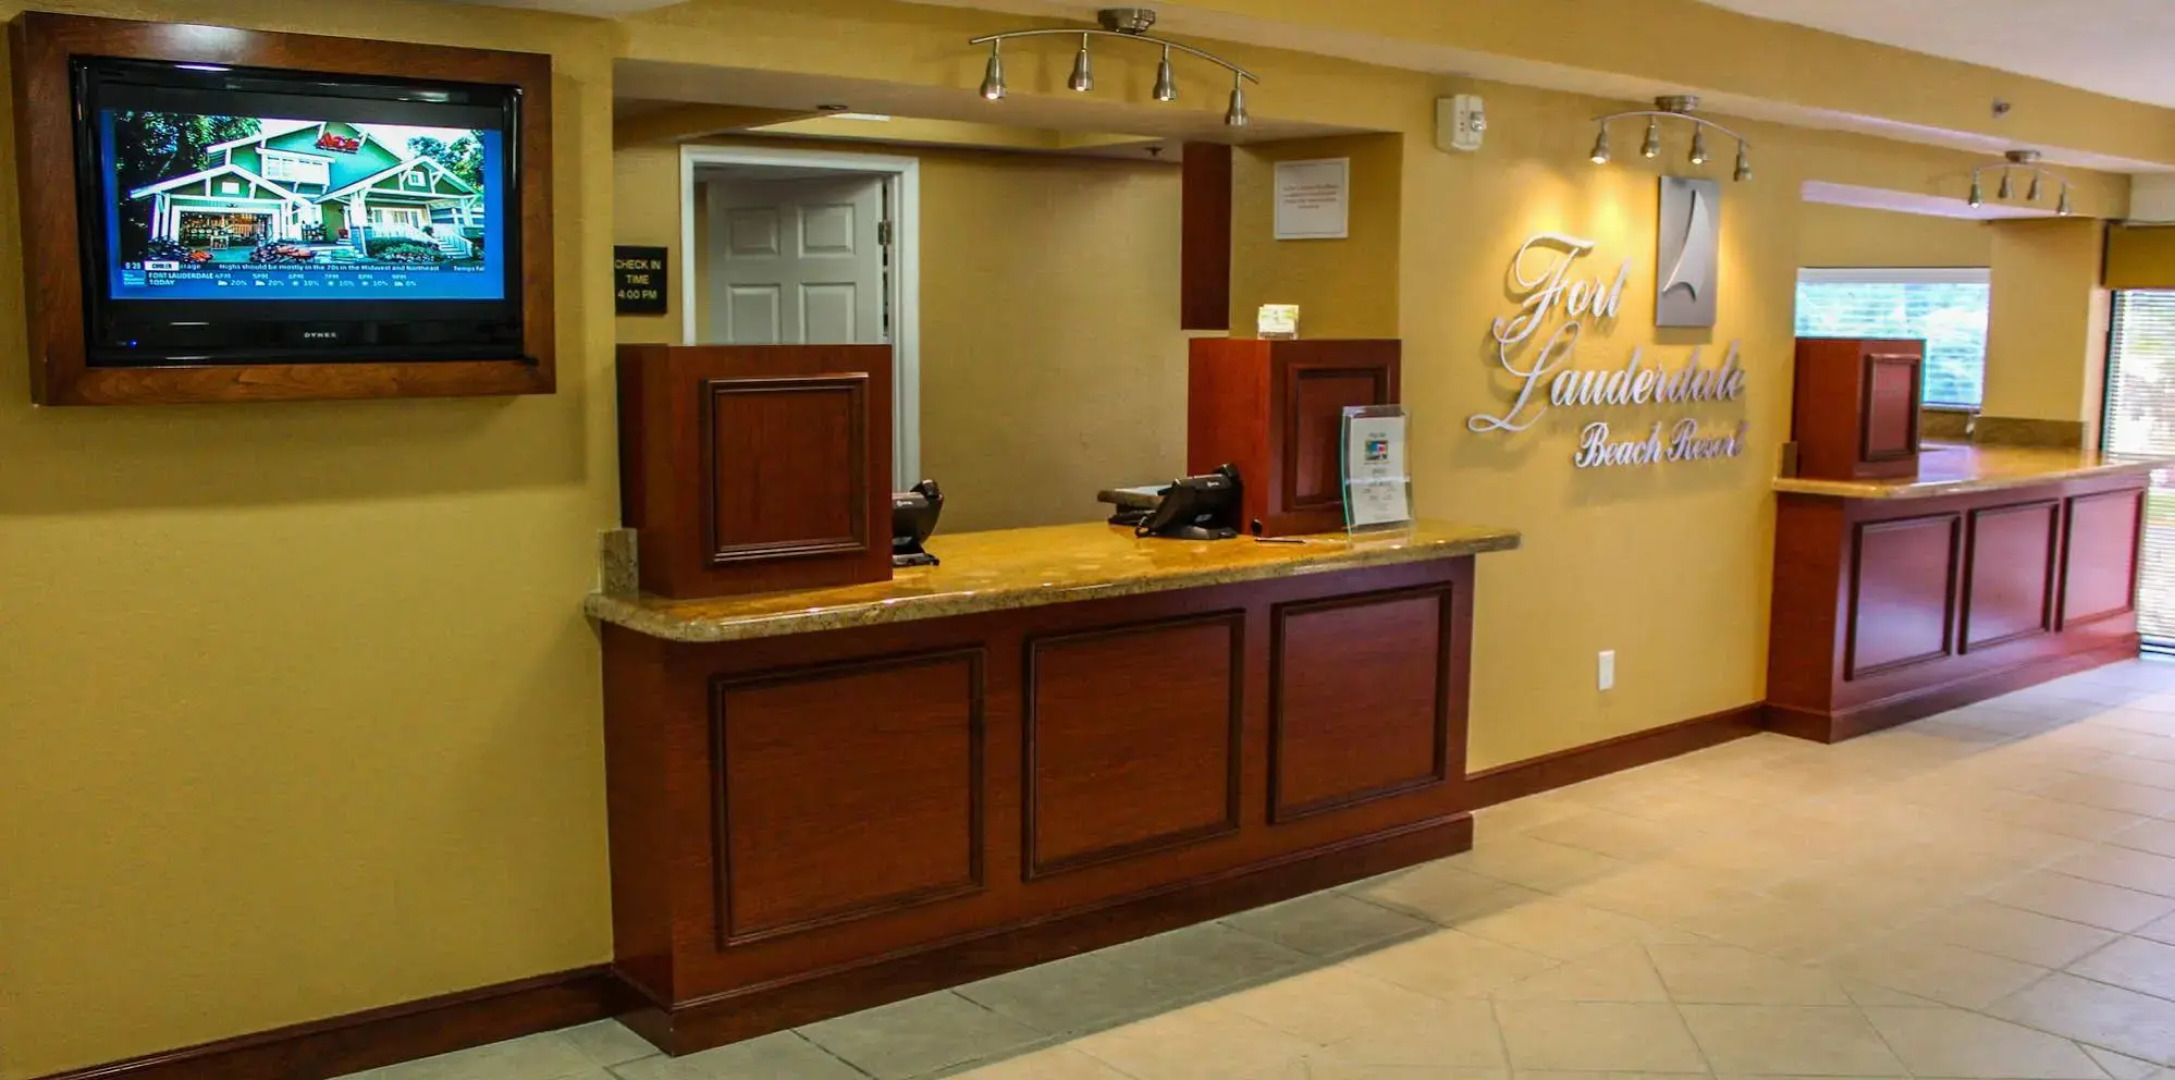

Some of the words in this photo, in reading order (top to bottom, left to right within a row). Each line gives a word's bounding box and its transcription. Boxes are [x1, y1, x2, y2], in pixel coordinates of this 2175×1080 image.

[614, 259, 649, 270] CHECK
[650, 260, 662, 270] IN
[626, 274, 650, 285] TIME
[641, 290, 658, 300] PM
[1493, 232, 1633, 344] Fort
[1468, 320, 1746, 432] Lauderdale
[1574, 421, 1662, 467] Beach
[1667, 418, 1750, 461] Resort
